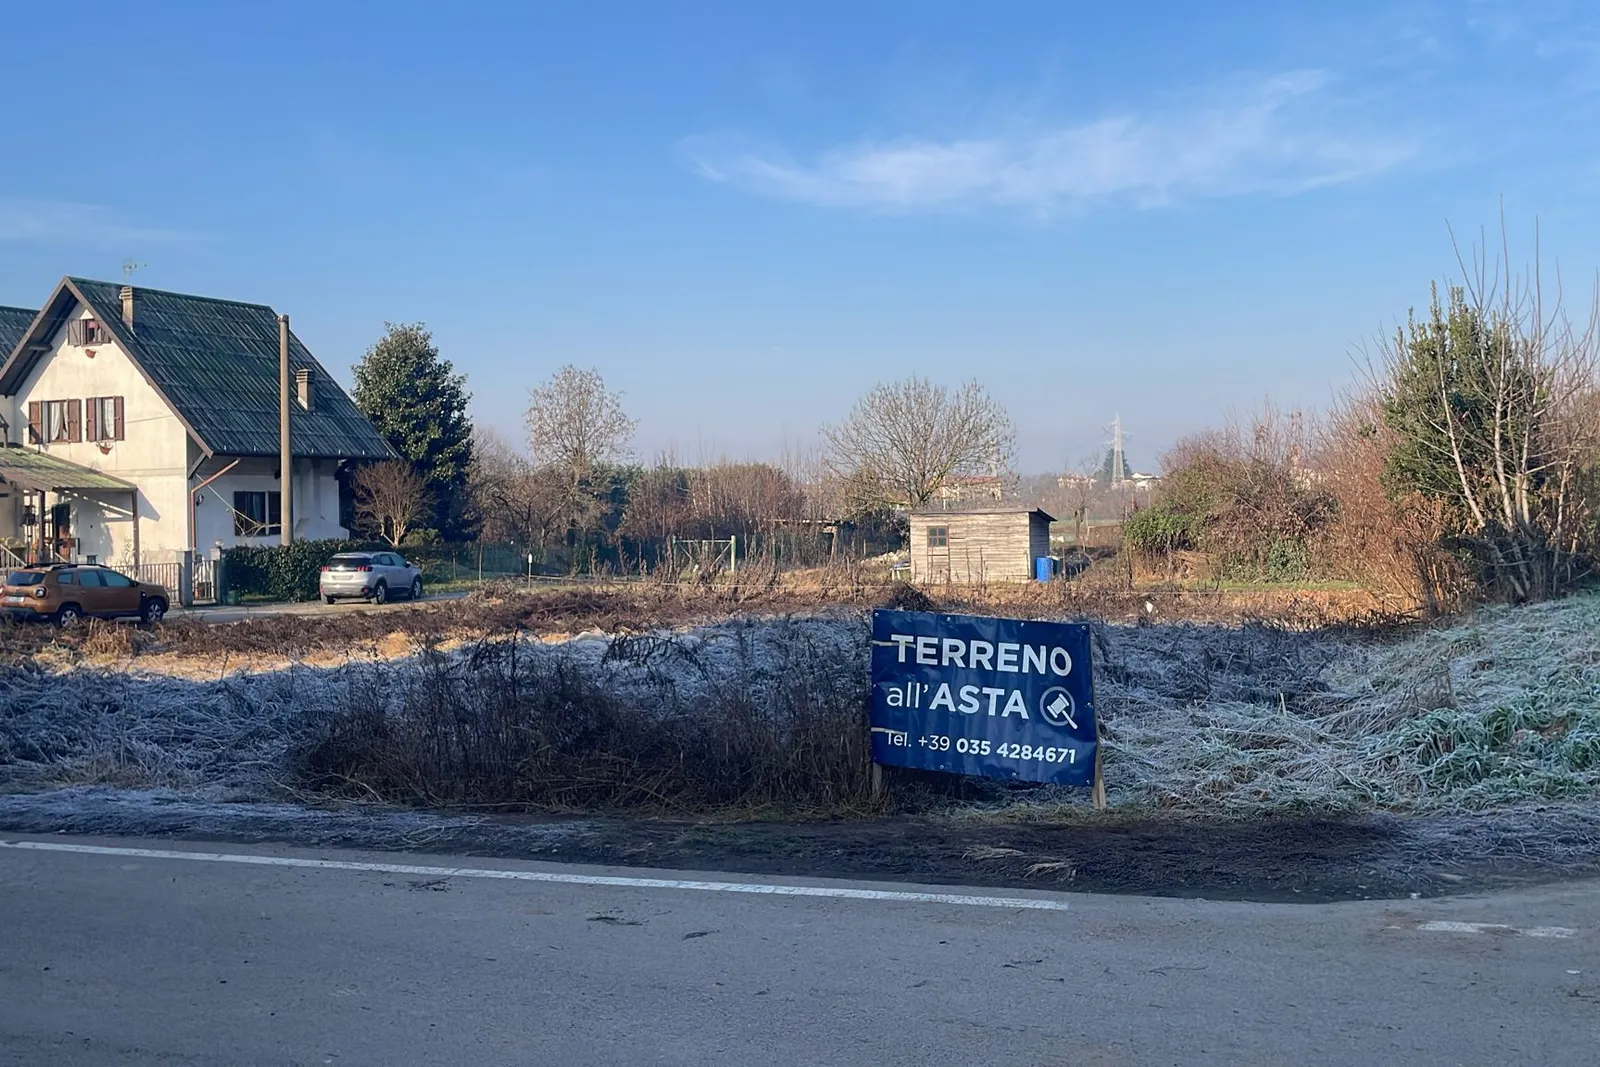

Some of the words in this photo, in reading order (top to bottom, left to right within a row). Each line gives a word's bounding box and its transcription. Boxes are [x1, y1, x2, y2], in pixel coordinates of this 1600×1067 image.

[891, 634, 1072, 677] TERRENO
[886, 681, 1029, 719] all'ASTA
[886, 731, 912, 748] Tel.
[918, 735, 950, 751] +39
[956, 738, 991, 755] 035
[996, 742, 1076, 764] 4284671
